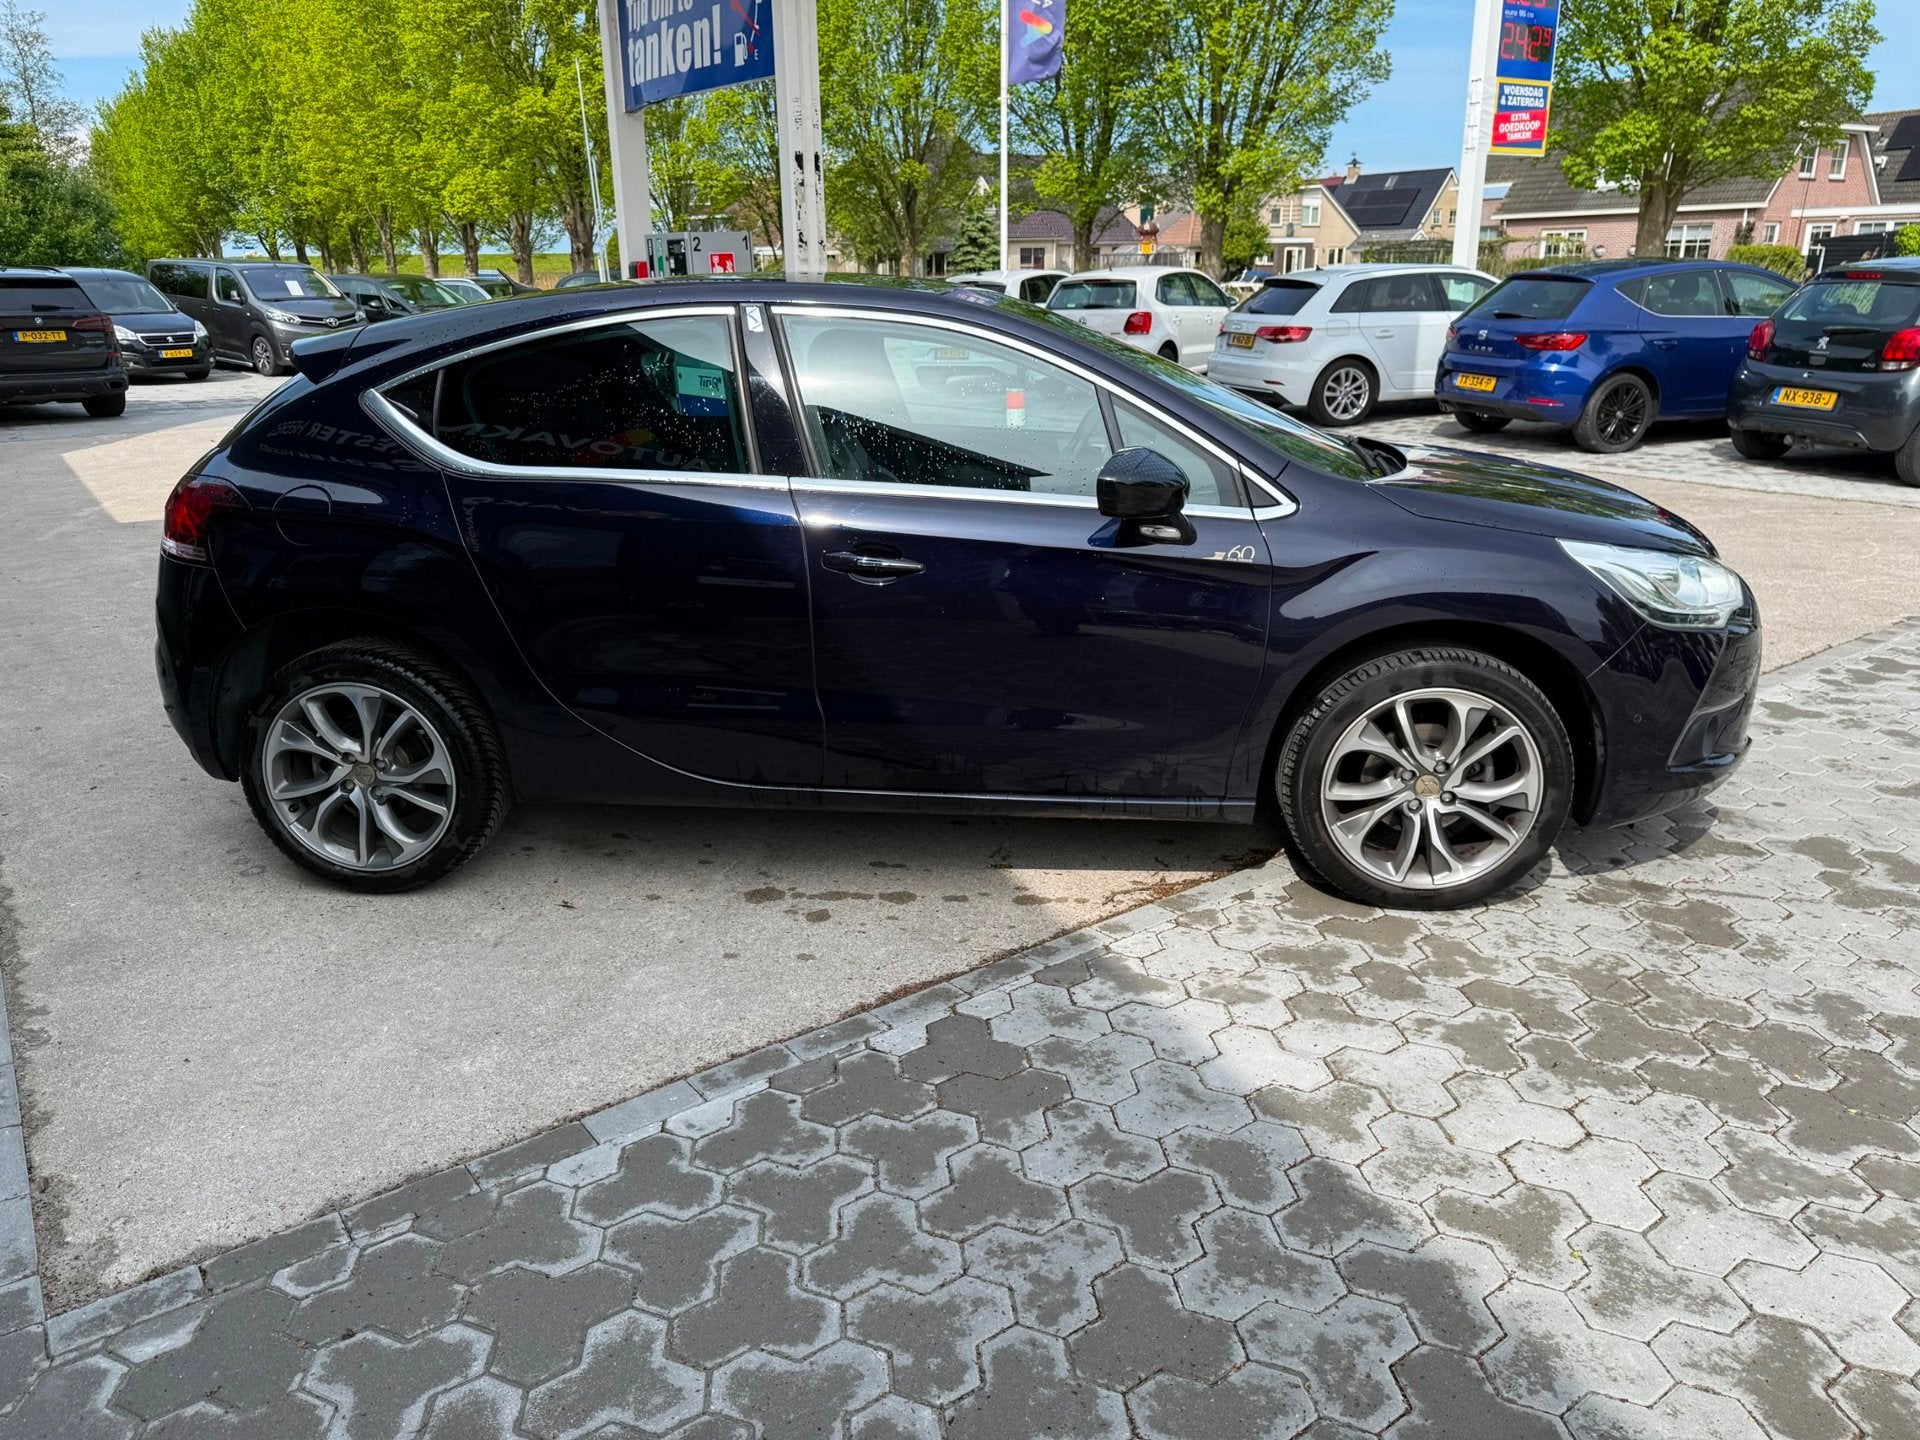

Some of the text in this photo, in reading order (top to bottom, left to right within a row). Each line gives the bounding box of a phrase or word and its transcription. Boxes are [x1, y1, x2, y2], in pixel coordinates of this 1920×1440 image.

[626, 0, 648, 32] Tijd
[628, 4, 721, 87] tanken!
[754, 49, 759, 61] E
[1504, 85, 1543, 97] WOENSDAG
[1500, 97, 1544, 108] & ZATERDAG
[1511, 113, 1530, 122] EXTRA
[1499, 121, 1541, 133] GOEDKOOP
[693, 238, 701, 251] 2
[742, 235, 749, 251] 1
[22, 332, 62, 340] P-032-TT
[1460, 375, 1492, 387] TX-334-P
[1783, 390, 1832, 406] NX-938-J
[1228, 545, 1256, 559] 60
